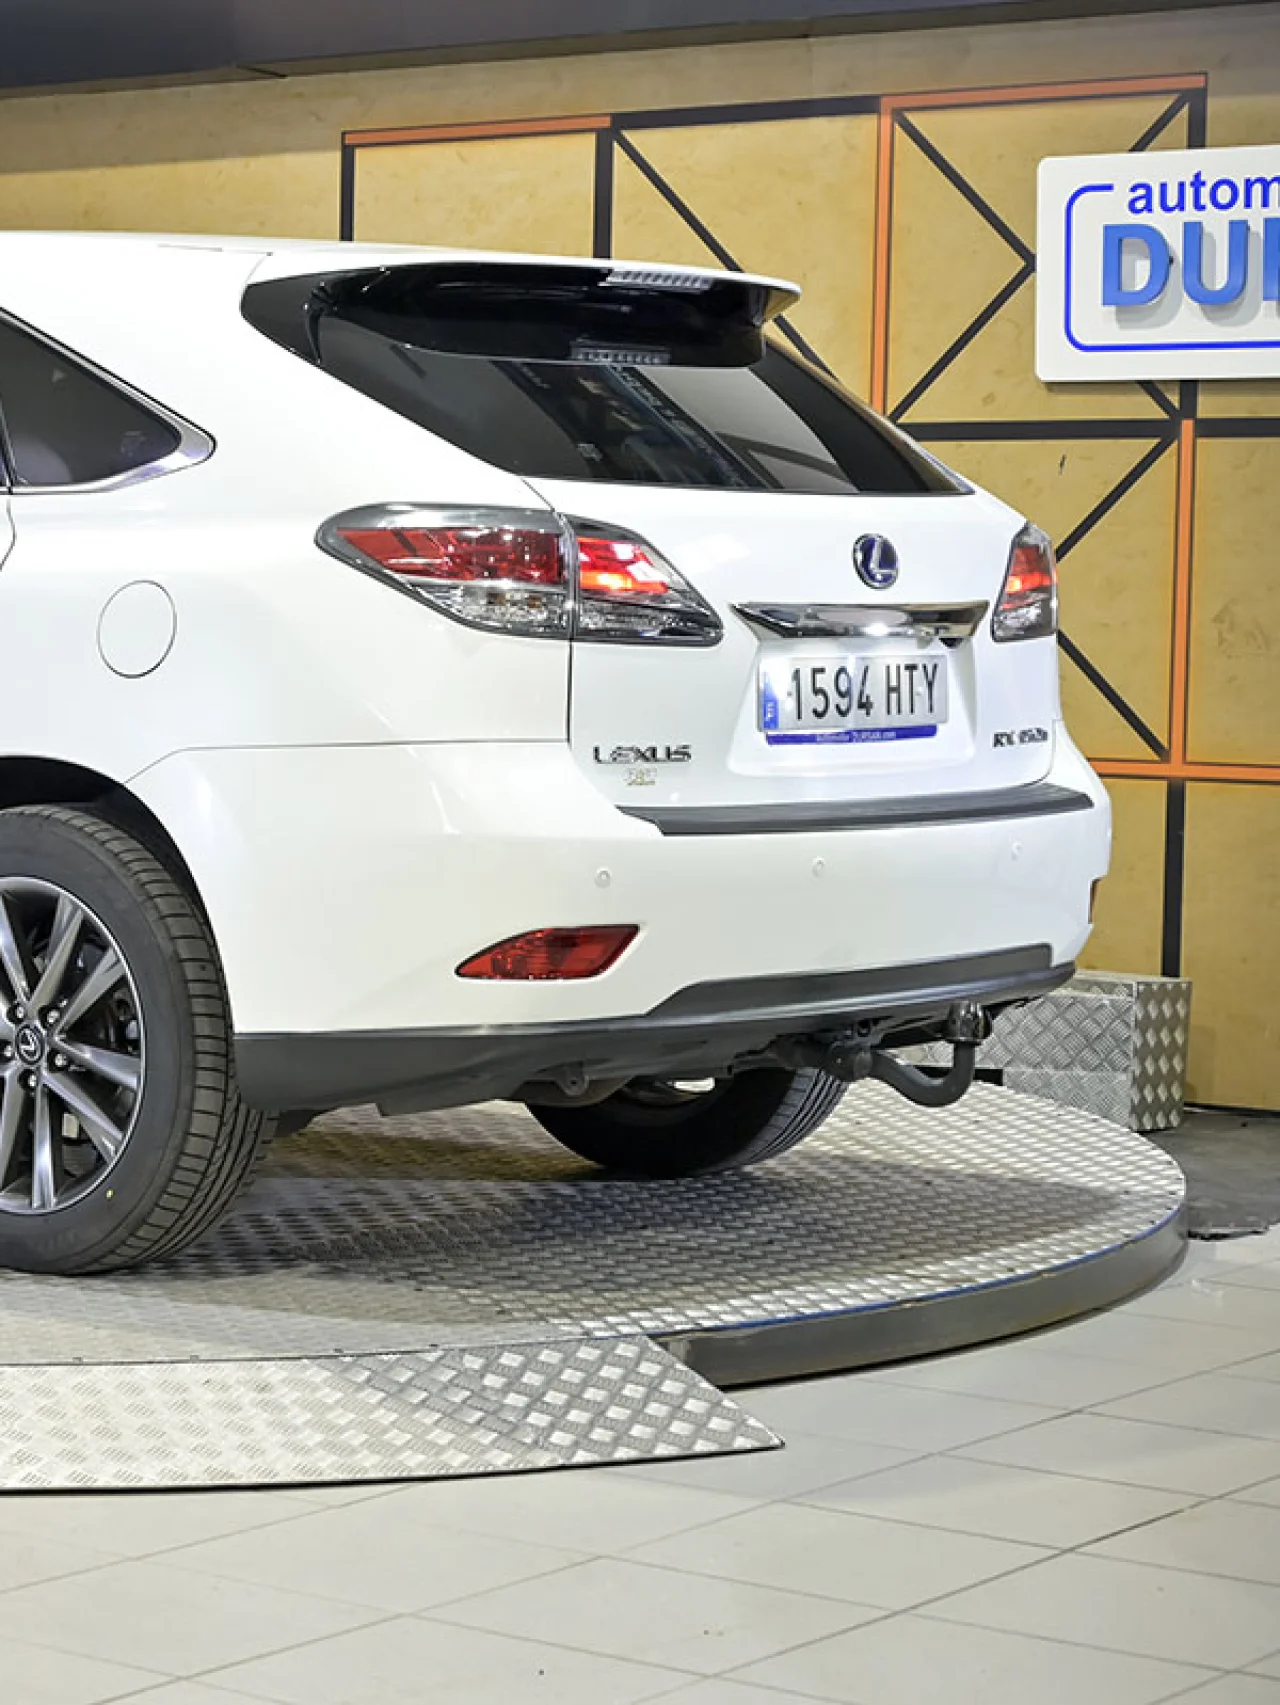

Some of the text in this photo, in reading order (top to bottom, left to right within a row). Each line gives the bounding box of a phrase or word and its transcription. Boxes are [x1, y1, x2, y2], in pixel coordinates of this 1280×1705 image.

[1101, 217, 1280, 307] DU
[792, 663, 938, 721] 1594 HTY
[593, 744, 692, 764] LEXUS
